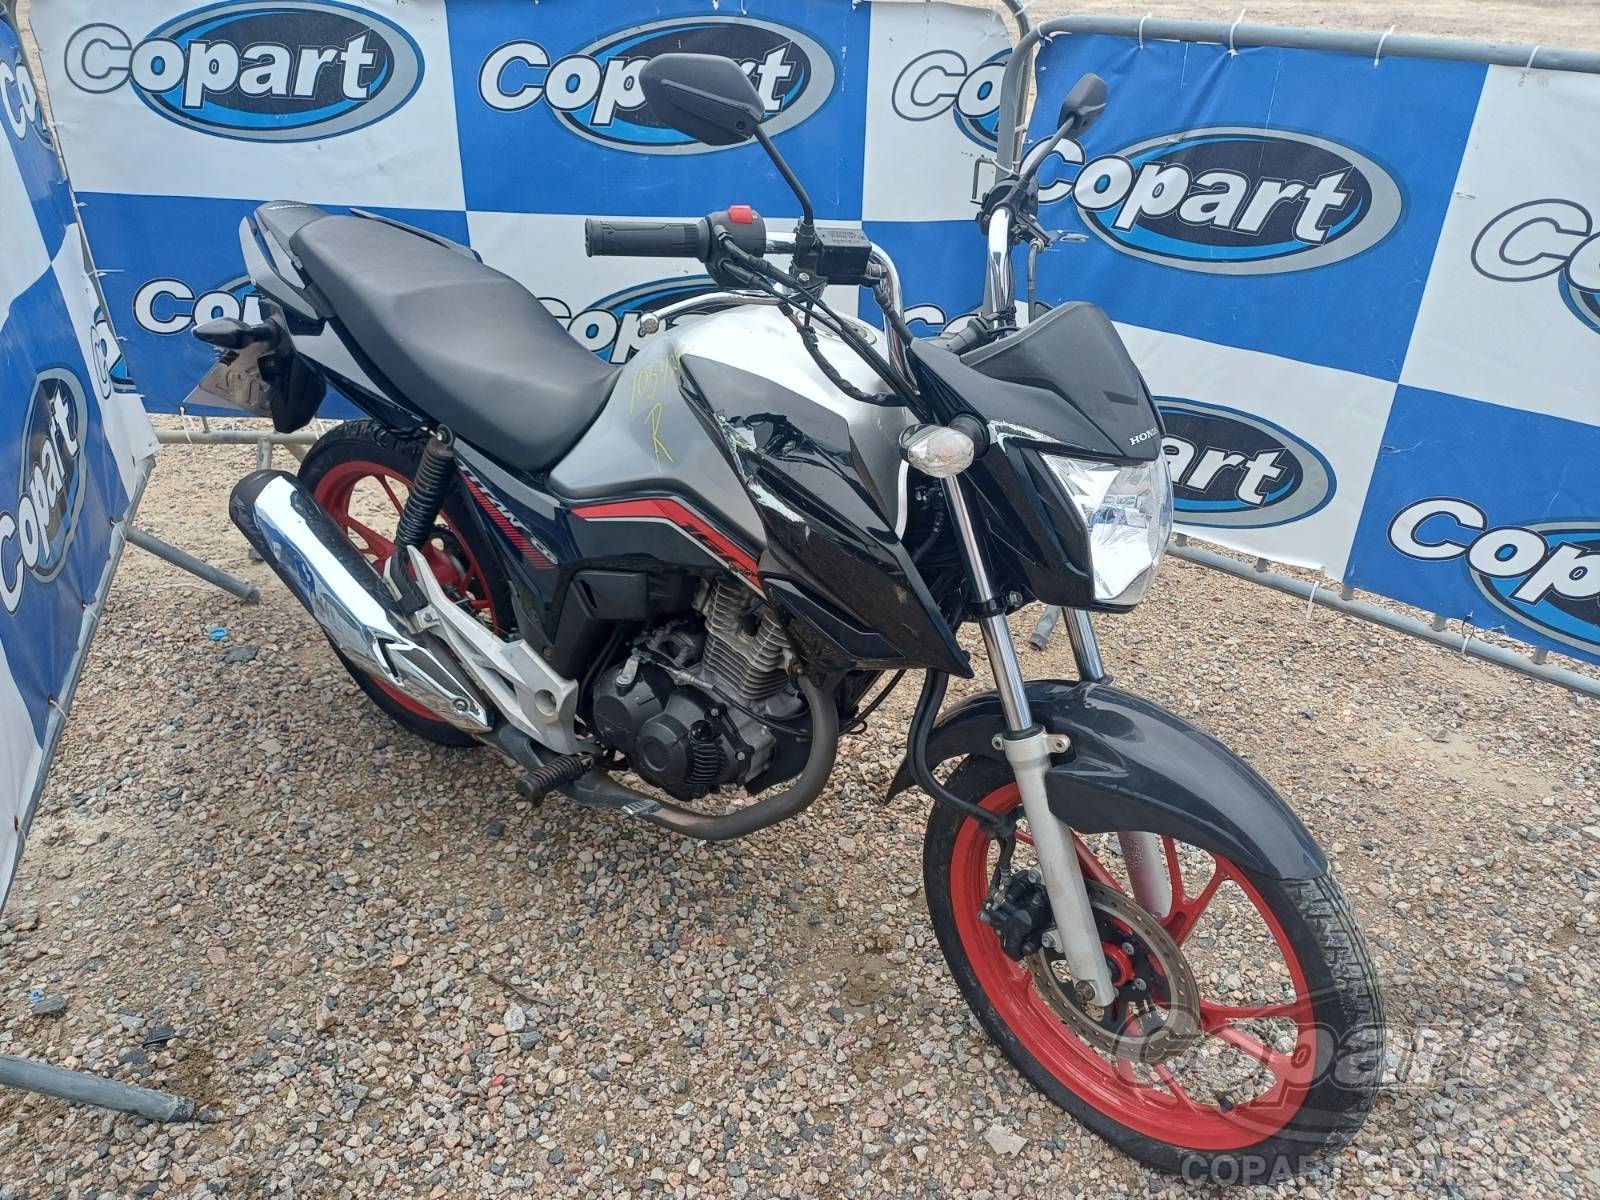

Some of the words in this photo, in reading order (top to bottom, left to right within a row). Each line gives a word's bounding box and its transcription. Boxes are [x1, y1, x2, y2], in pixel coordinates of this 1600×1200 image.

[64, 23, 377, 109] Copart
[479, 39, 797, 126] Copt
[1019, 136, 1358, 245] Copart
[644, 402, 674, 473] R
[1129, 427, 1159, 446] HON
[0, 379, 80, 615] Copart
[1387, 497, 1600, 606] Cop
